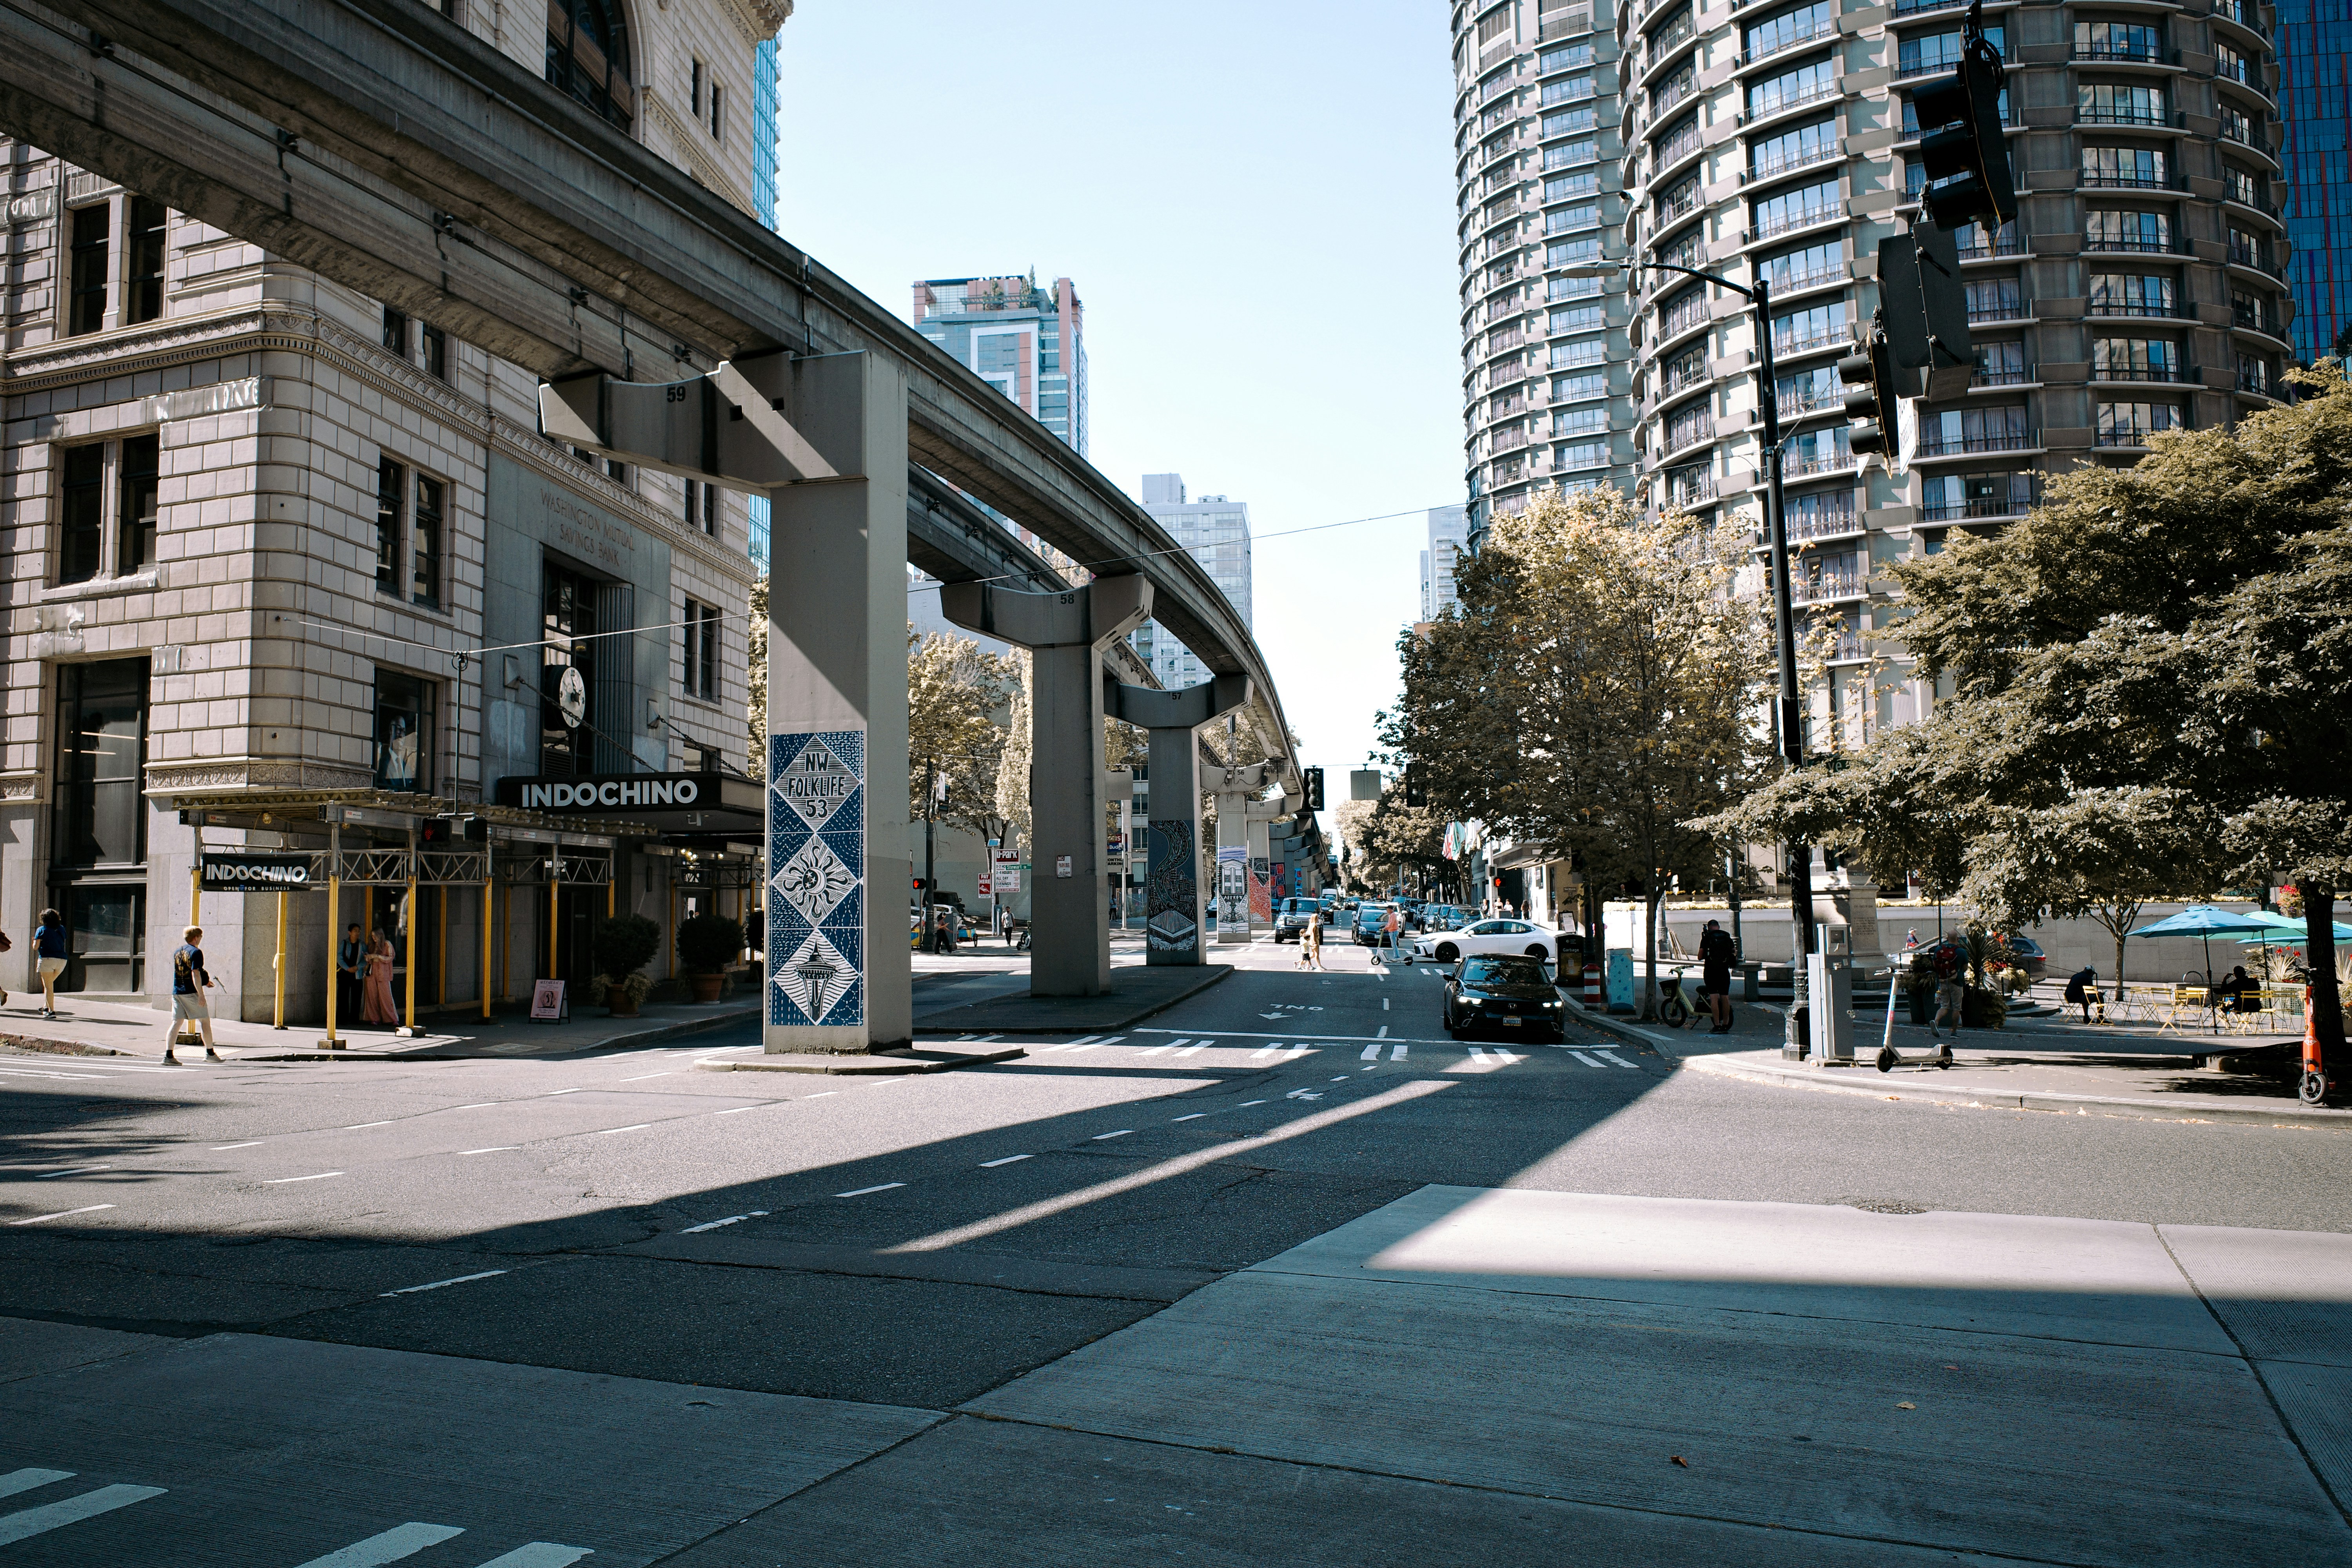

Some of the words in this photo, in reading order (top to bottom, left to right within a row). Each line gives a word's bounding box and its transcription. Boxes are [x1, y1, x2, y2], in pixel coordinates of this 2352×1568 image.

[667, 386, 686, 402] 59
[541, 488, 600, 532] WASHINGTON
[604, 521, 635, 551] MUTUAL
[561, 524, 594, 554] SAVINGS
[599, 542, 619, 566] BANK
[1060, 594, 1074, 604] 58
[806, 753, 829, 771] NW
[522, 779, 698, 808] INDOCHINO
[788, 777, 845, 797] FOLKLIFE
[806, 799, 828, 818] 53
[206, 864, 306, 882] INDOCHINO
